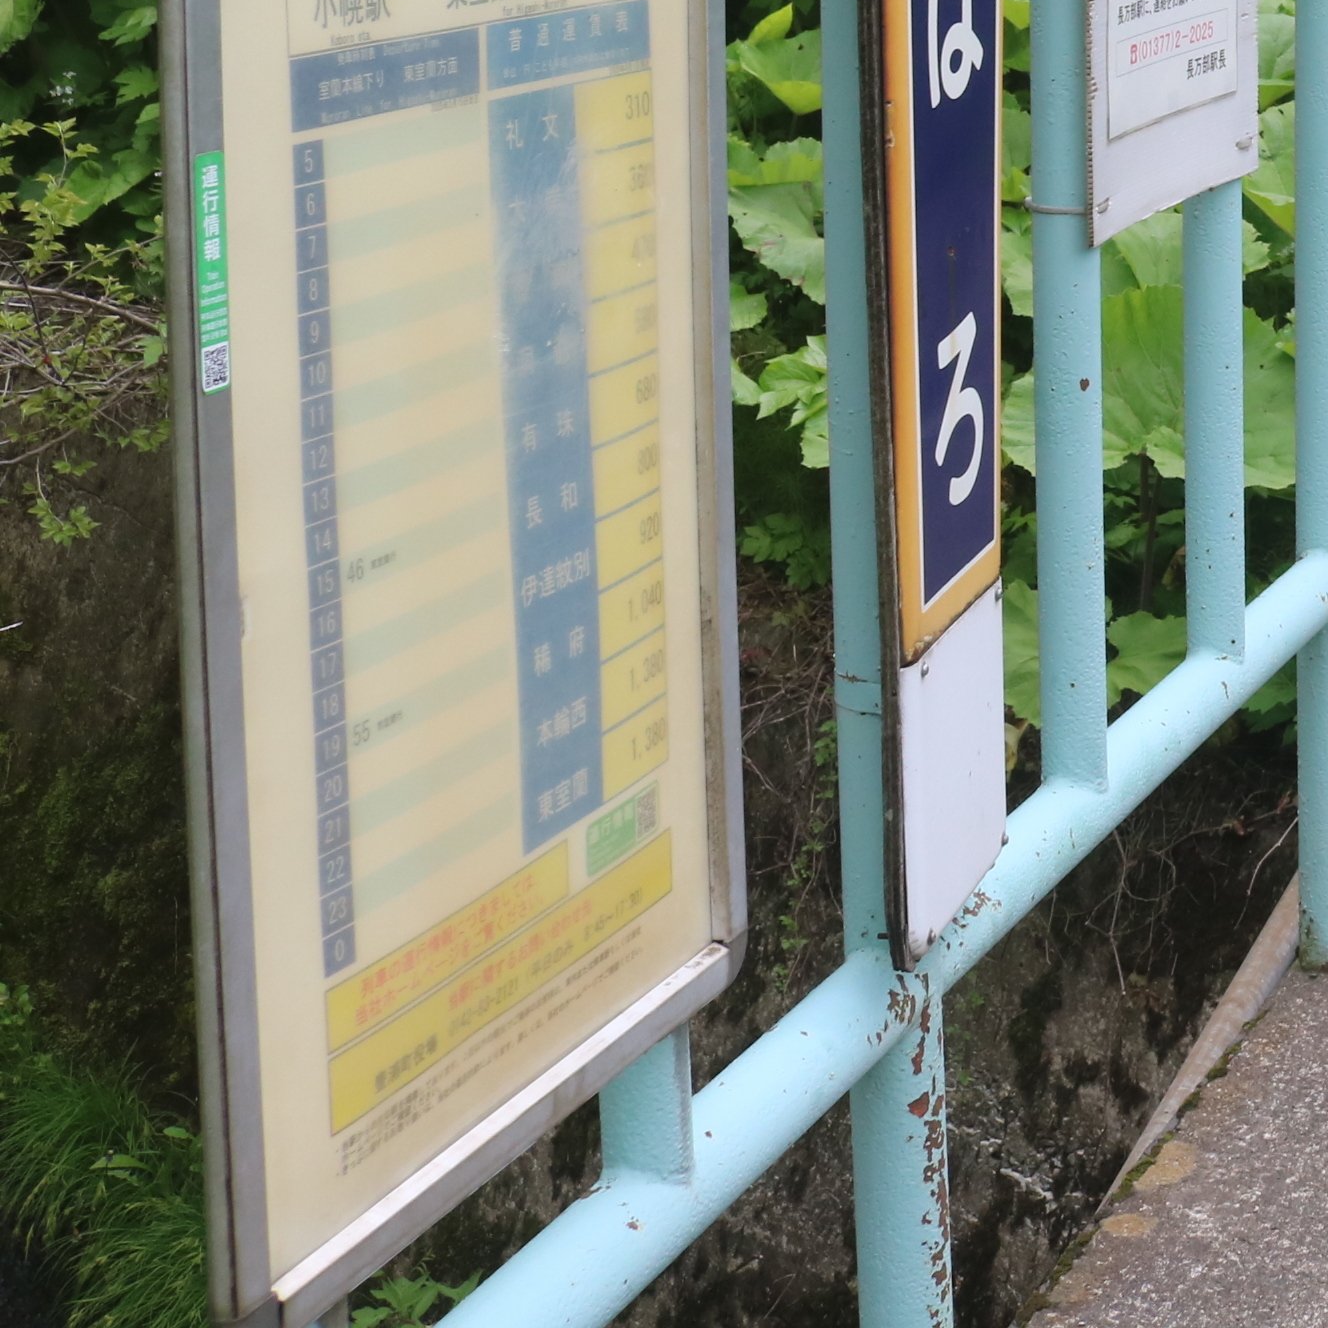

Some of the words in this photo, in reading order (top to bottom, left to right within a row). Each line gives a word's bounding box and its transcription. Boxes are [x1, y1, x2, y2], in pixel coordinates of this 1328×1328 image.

[1186, 48, 1227, 80] 長万部駅長
[505, 114, 560, 150] 礼文
[625, 94, 650, 121] 310
[202, 165, 221, 261] 運行情報
[525, 481, 579, 529] 長和
[521, 548, 590, 608] 伊達紋別
